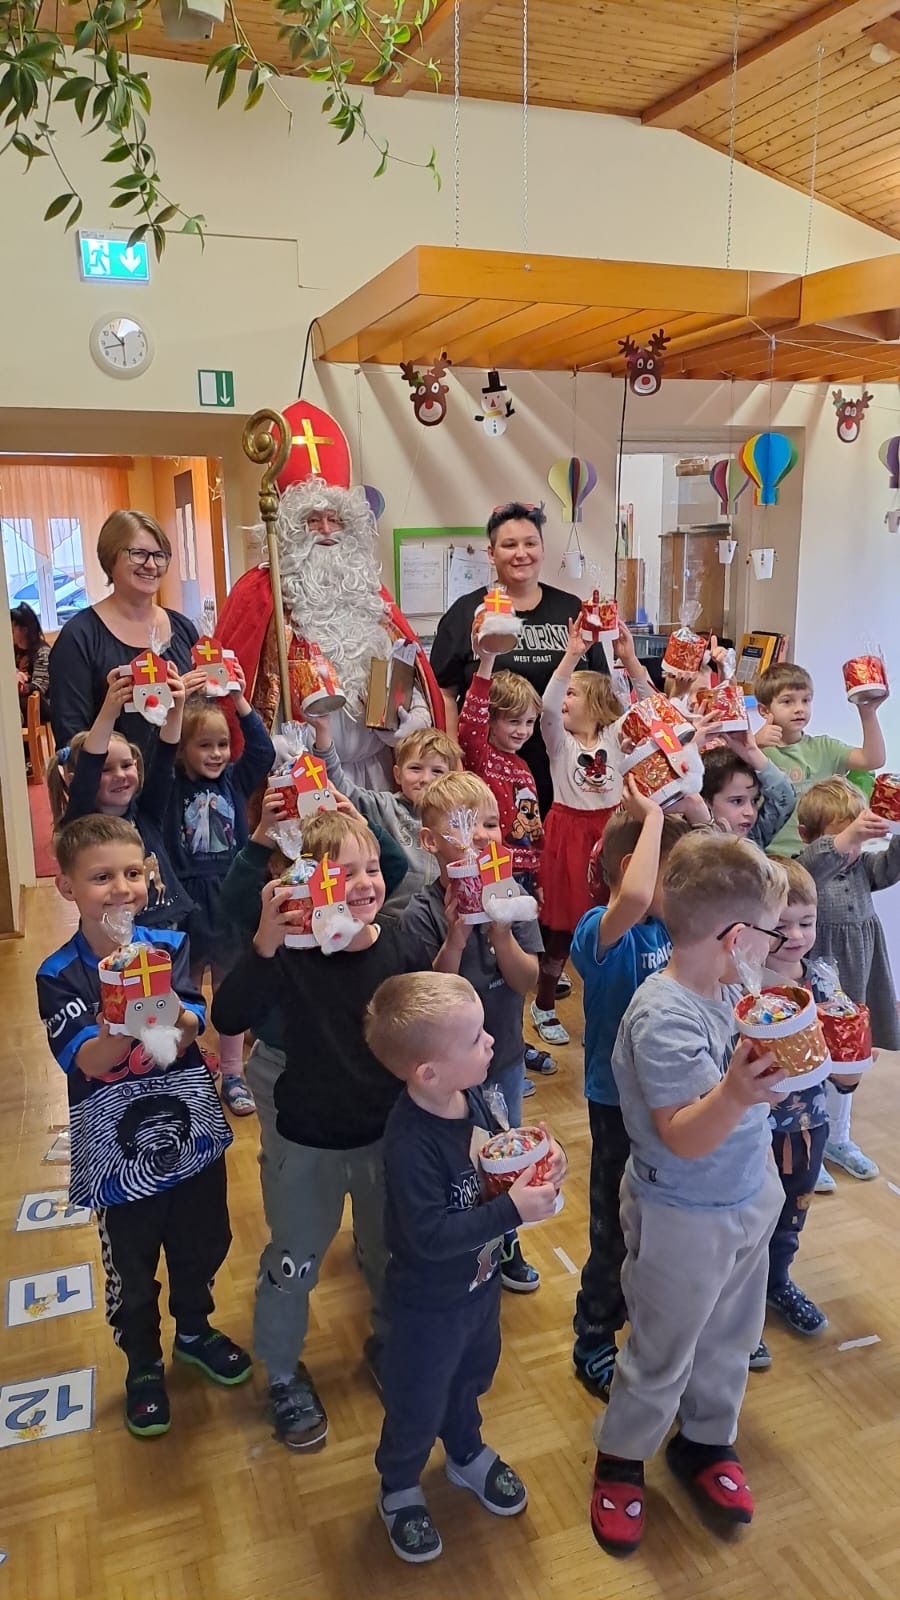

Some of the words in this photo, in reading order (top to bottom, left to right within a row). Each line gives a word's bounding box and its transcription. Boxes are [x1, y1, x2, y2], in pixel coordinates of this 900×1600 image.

[513, 655, 530, 663] WEST
[532, 655, 552, 663] COAST
[5, 1385, 83, 1430] 12
